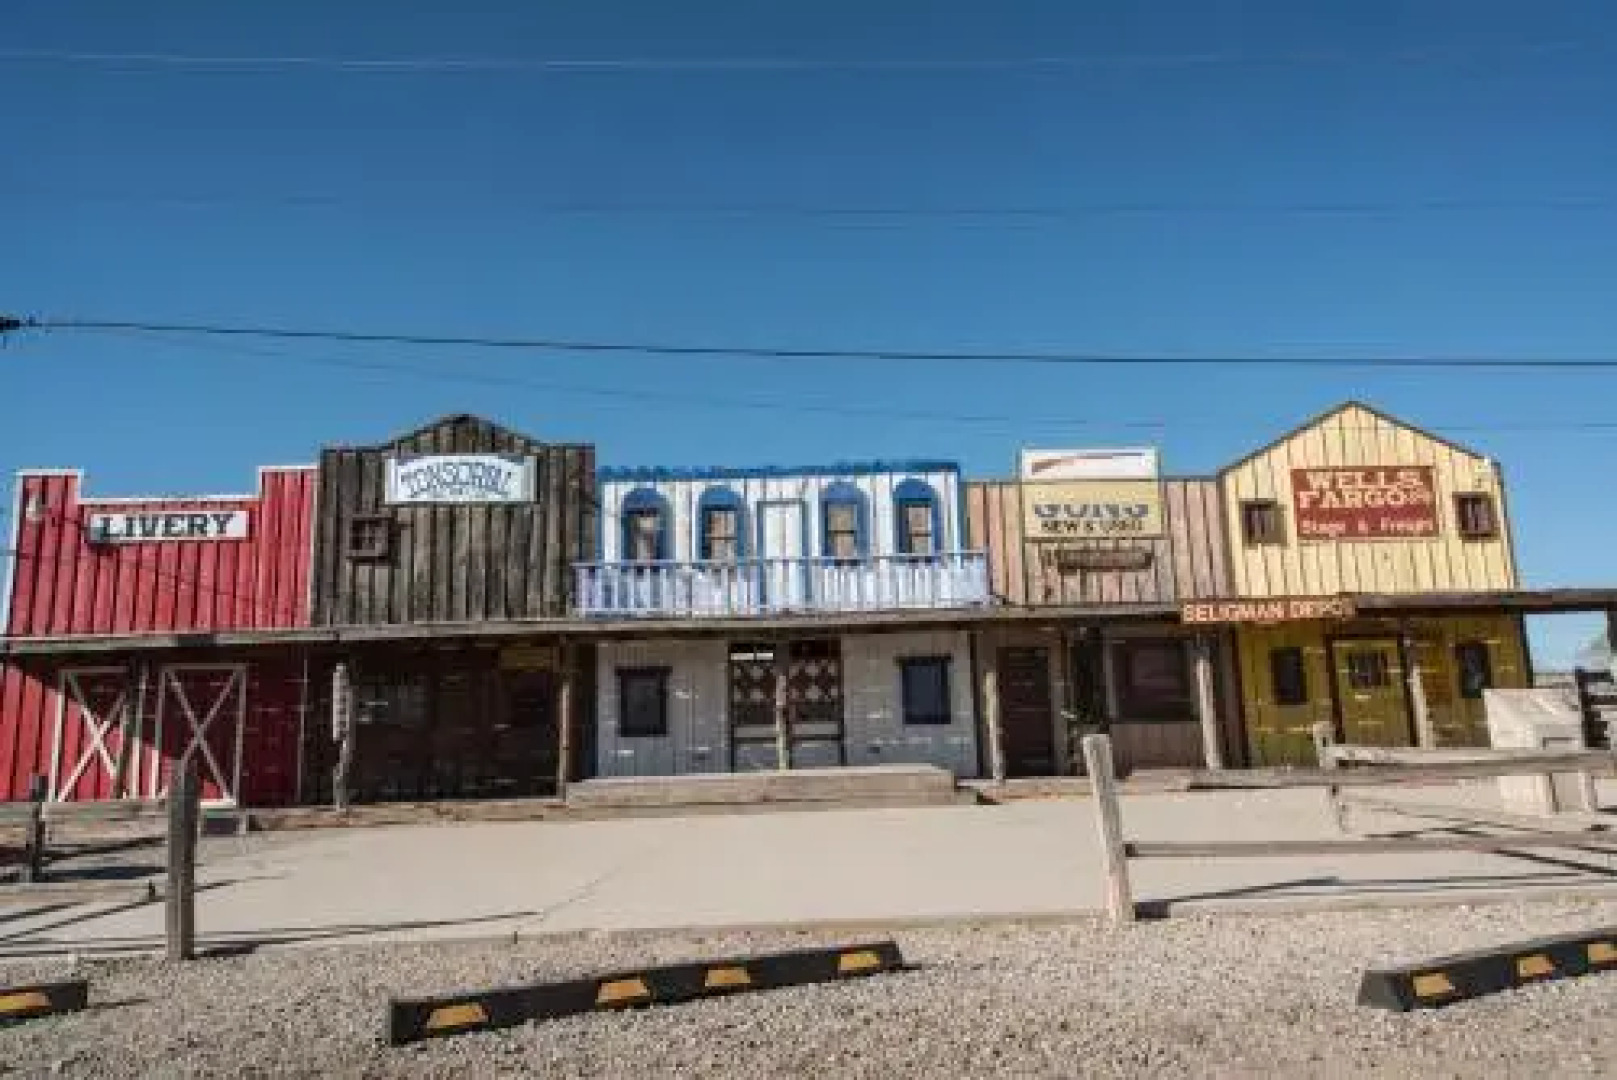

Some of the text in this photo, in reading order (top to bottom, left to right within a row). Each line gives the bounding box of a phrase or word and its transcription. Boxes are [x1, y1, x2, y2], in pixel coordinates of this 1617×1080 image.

[400, 461, 512, 498] TONSORL
[1306, 471, 1423, 489] WELLS
[1298, 489, 1407, 508] FARGO
[101, 513, 234, 538] LIVERY
